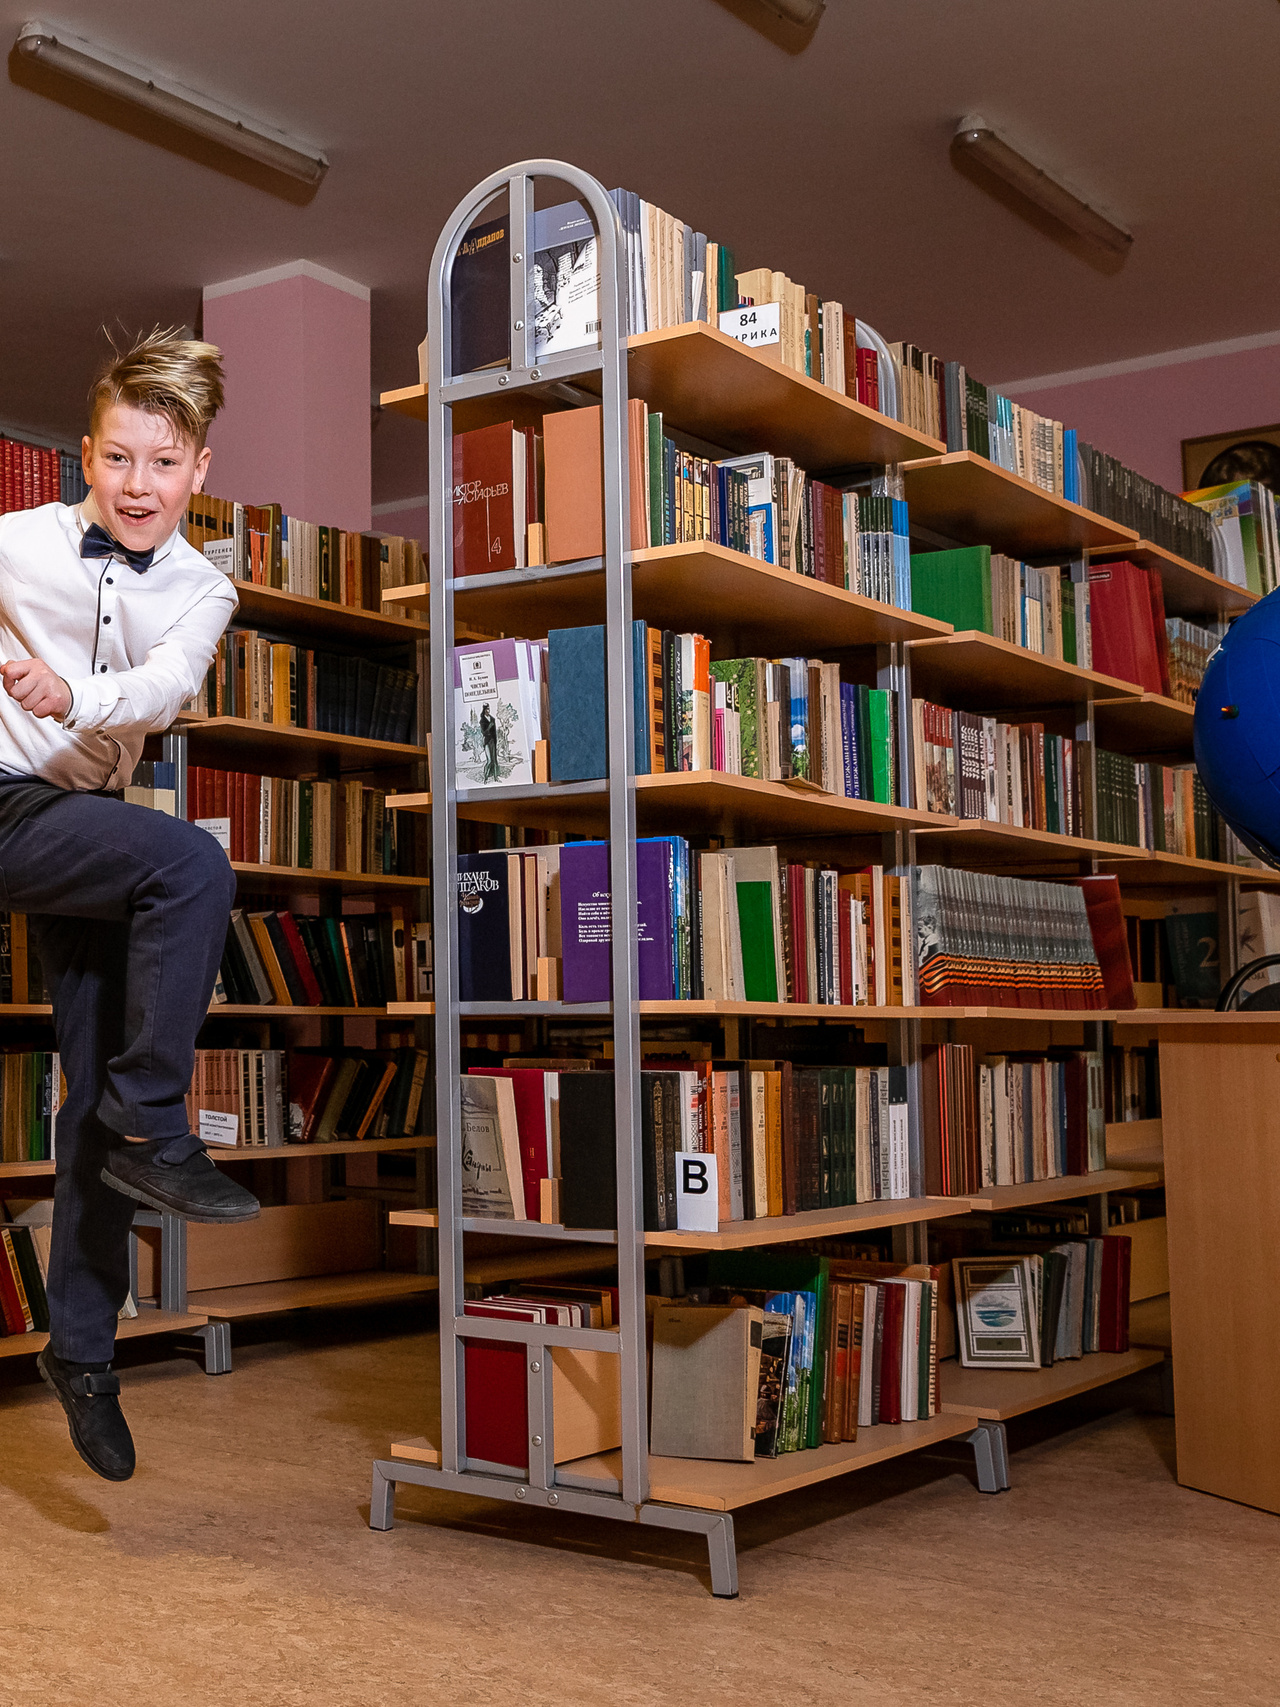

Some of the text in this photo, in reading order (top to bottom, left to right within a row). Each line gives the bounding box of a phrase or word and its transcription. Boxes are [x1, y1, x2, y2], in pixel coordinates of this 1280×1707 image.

[740, 312, 757, 326] 84
[735, 328, 777, 342] РИКА
[458, 483, 509, 505] АСТАФЬЕВ
[204, 547, 232, 555] ТУРГЕНЕВ
[490, 537, 501, 554] 4
[470, 681, 488, 689] ЧИСТЫЙ
[464, 688, 496, 697] ПОНЕДЕЛЬНИК
[422, 971, 433, 990] Т
[205, 1114, 228, 1122] ТОЛСТОЙ
[466, 1122, 490, 1133] Белов
[682, 1159, 708, 1195] В
